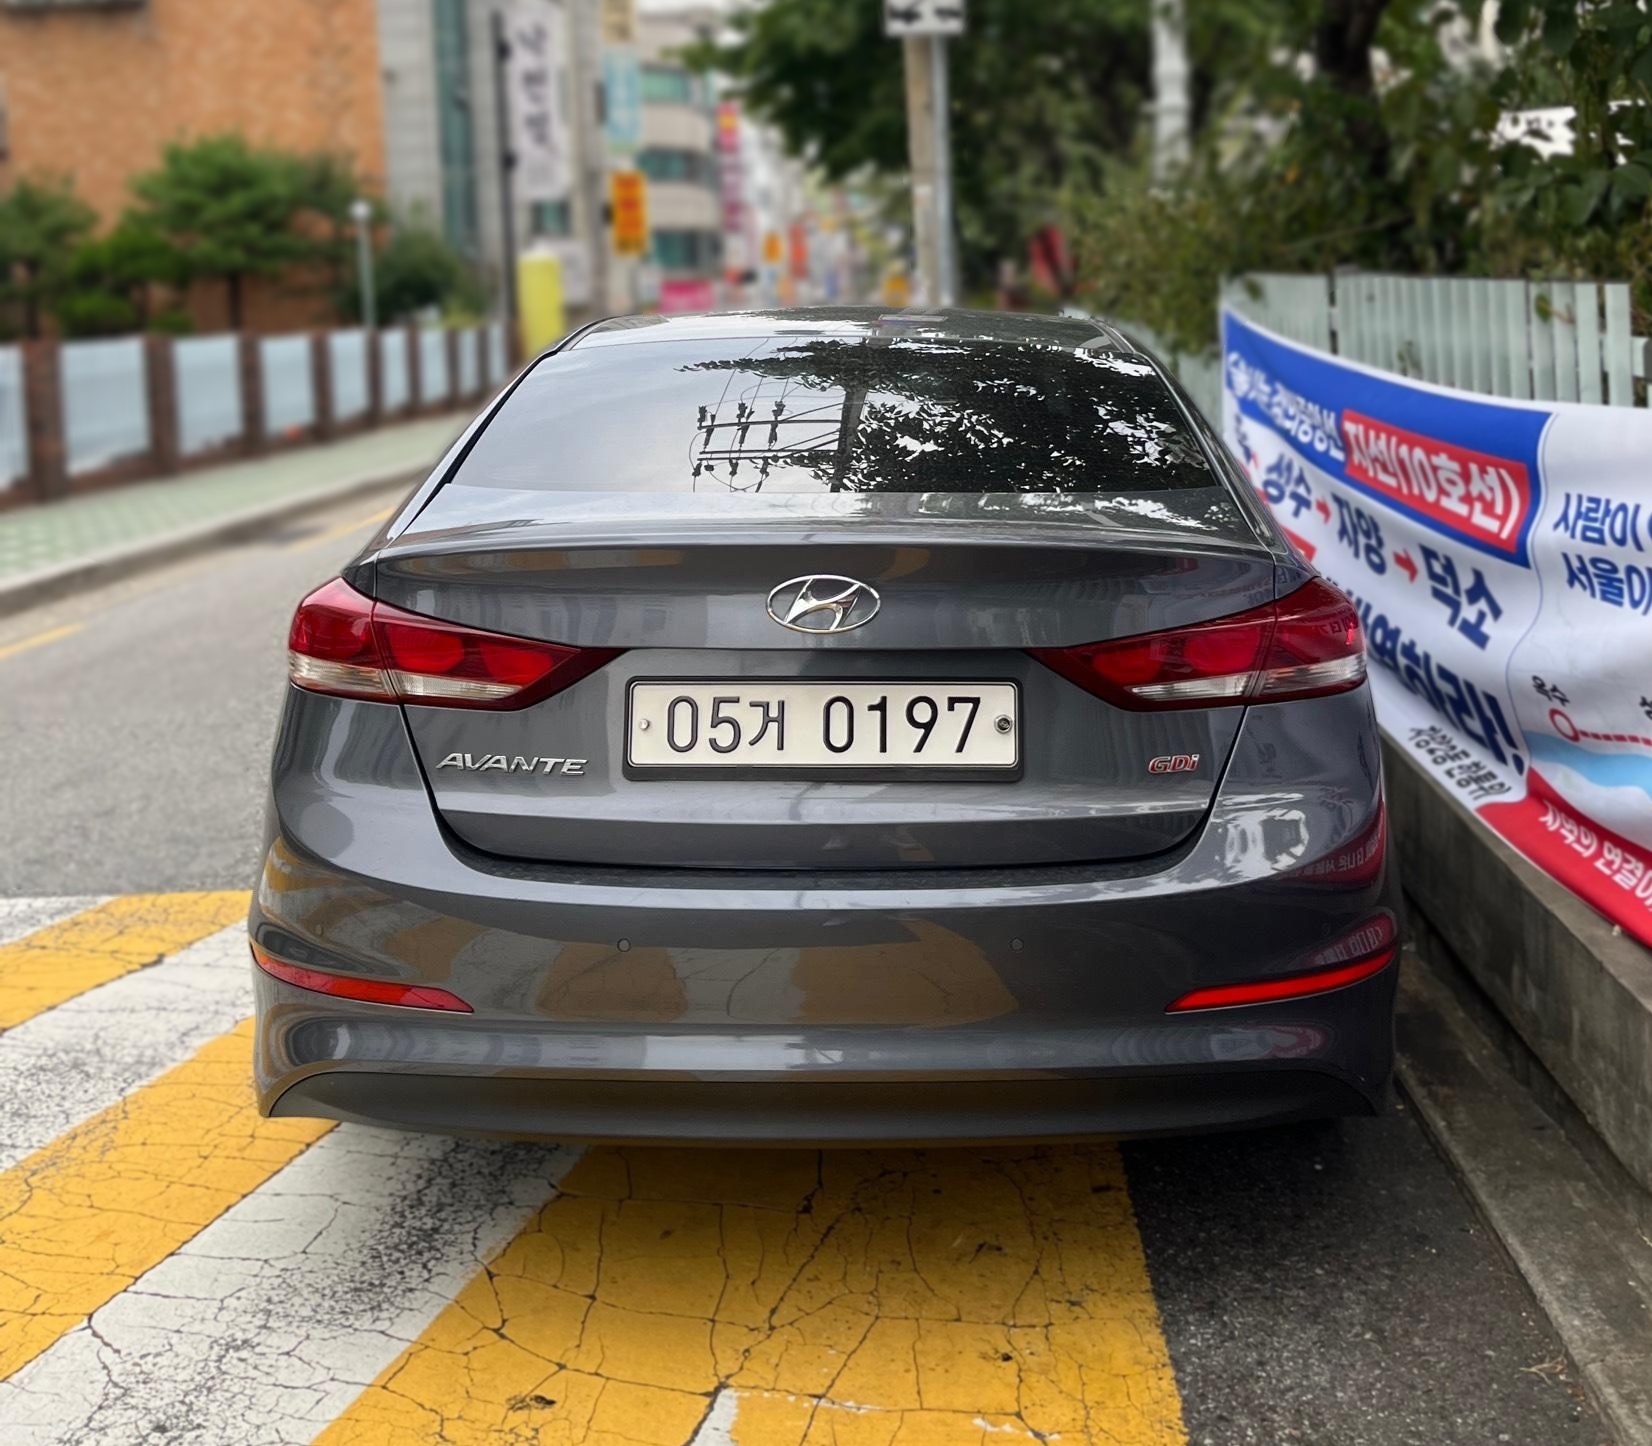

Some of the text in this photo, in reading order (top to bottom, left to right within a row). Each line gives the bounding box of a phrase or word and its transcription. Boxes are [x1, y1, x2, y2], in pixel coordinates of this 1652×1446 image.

[1343, 420, 1521, 540] 지선(10호선)
[1262, 454, 1504, 650] 성수 자양 덕소
[1552, 492, 1645, 553] 사람이
[1561, 551, 1652, 616] 서울이
[1531, 675, 1570, 707] 옥수
[666, 695, 982, 753] 05거 0197
[435, 752, 588, 776] AVANTE
[1147, 754, 1200, 774] GDi
